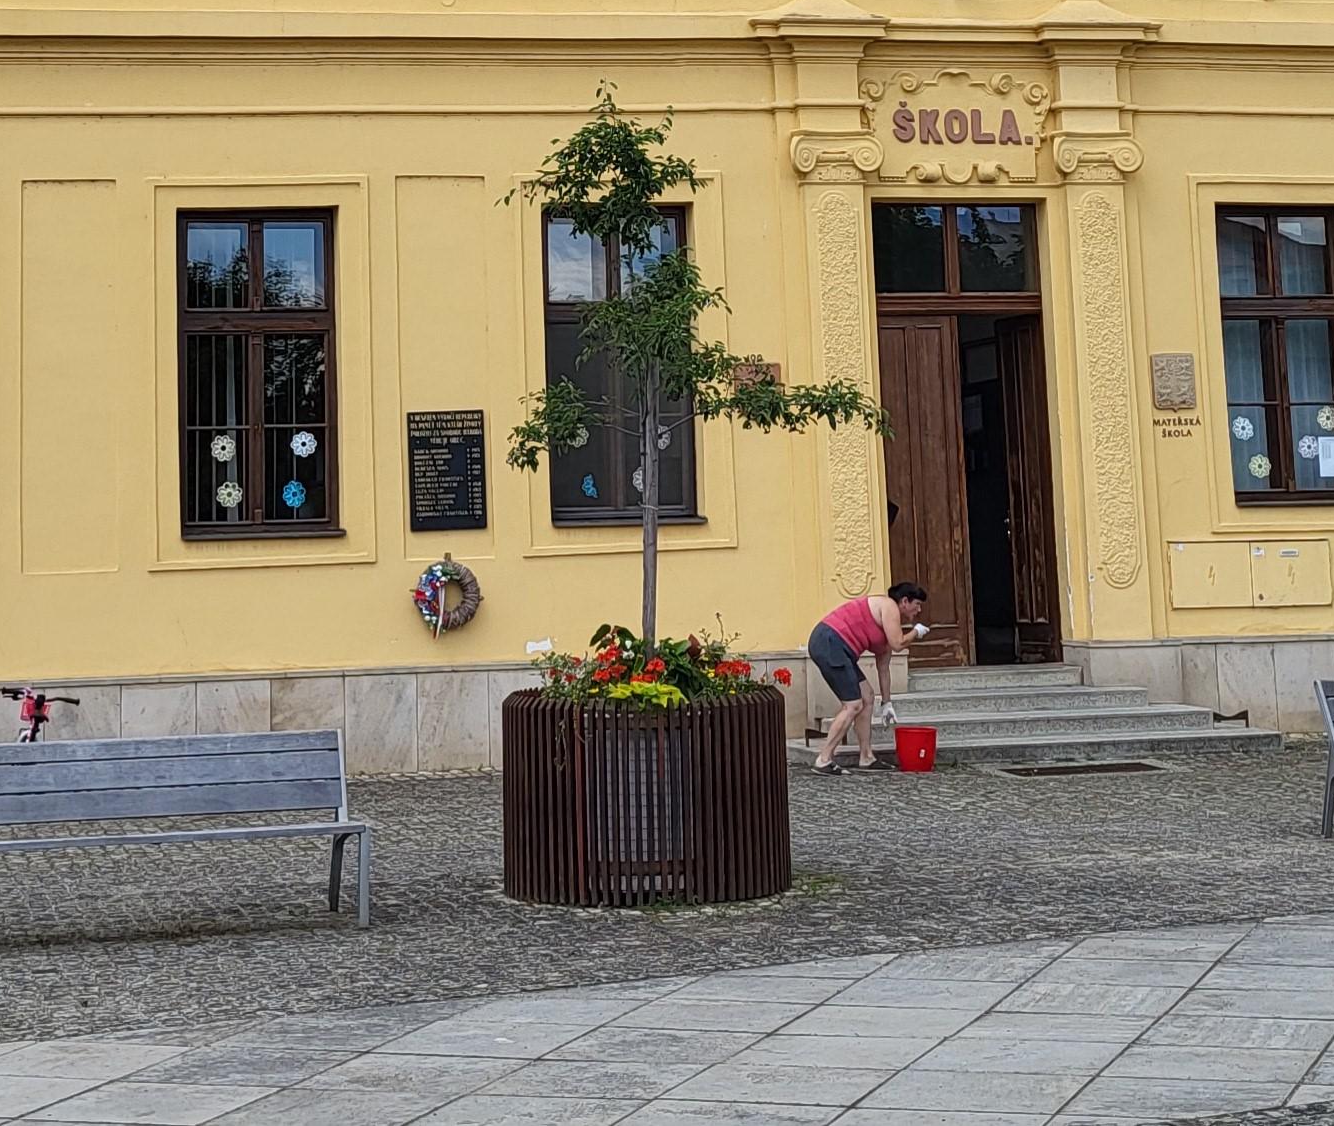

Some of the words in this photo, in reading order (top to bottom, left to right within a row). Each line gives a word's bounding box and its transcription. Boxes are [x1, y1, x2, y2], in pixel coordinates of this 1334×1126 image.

[892, 101, 1034, 145] ŠKOLA.
[1152, 415, 1201, 426] MATEŘSKÁ
[1162, 428, 1192, 438] ŠKOLA
